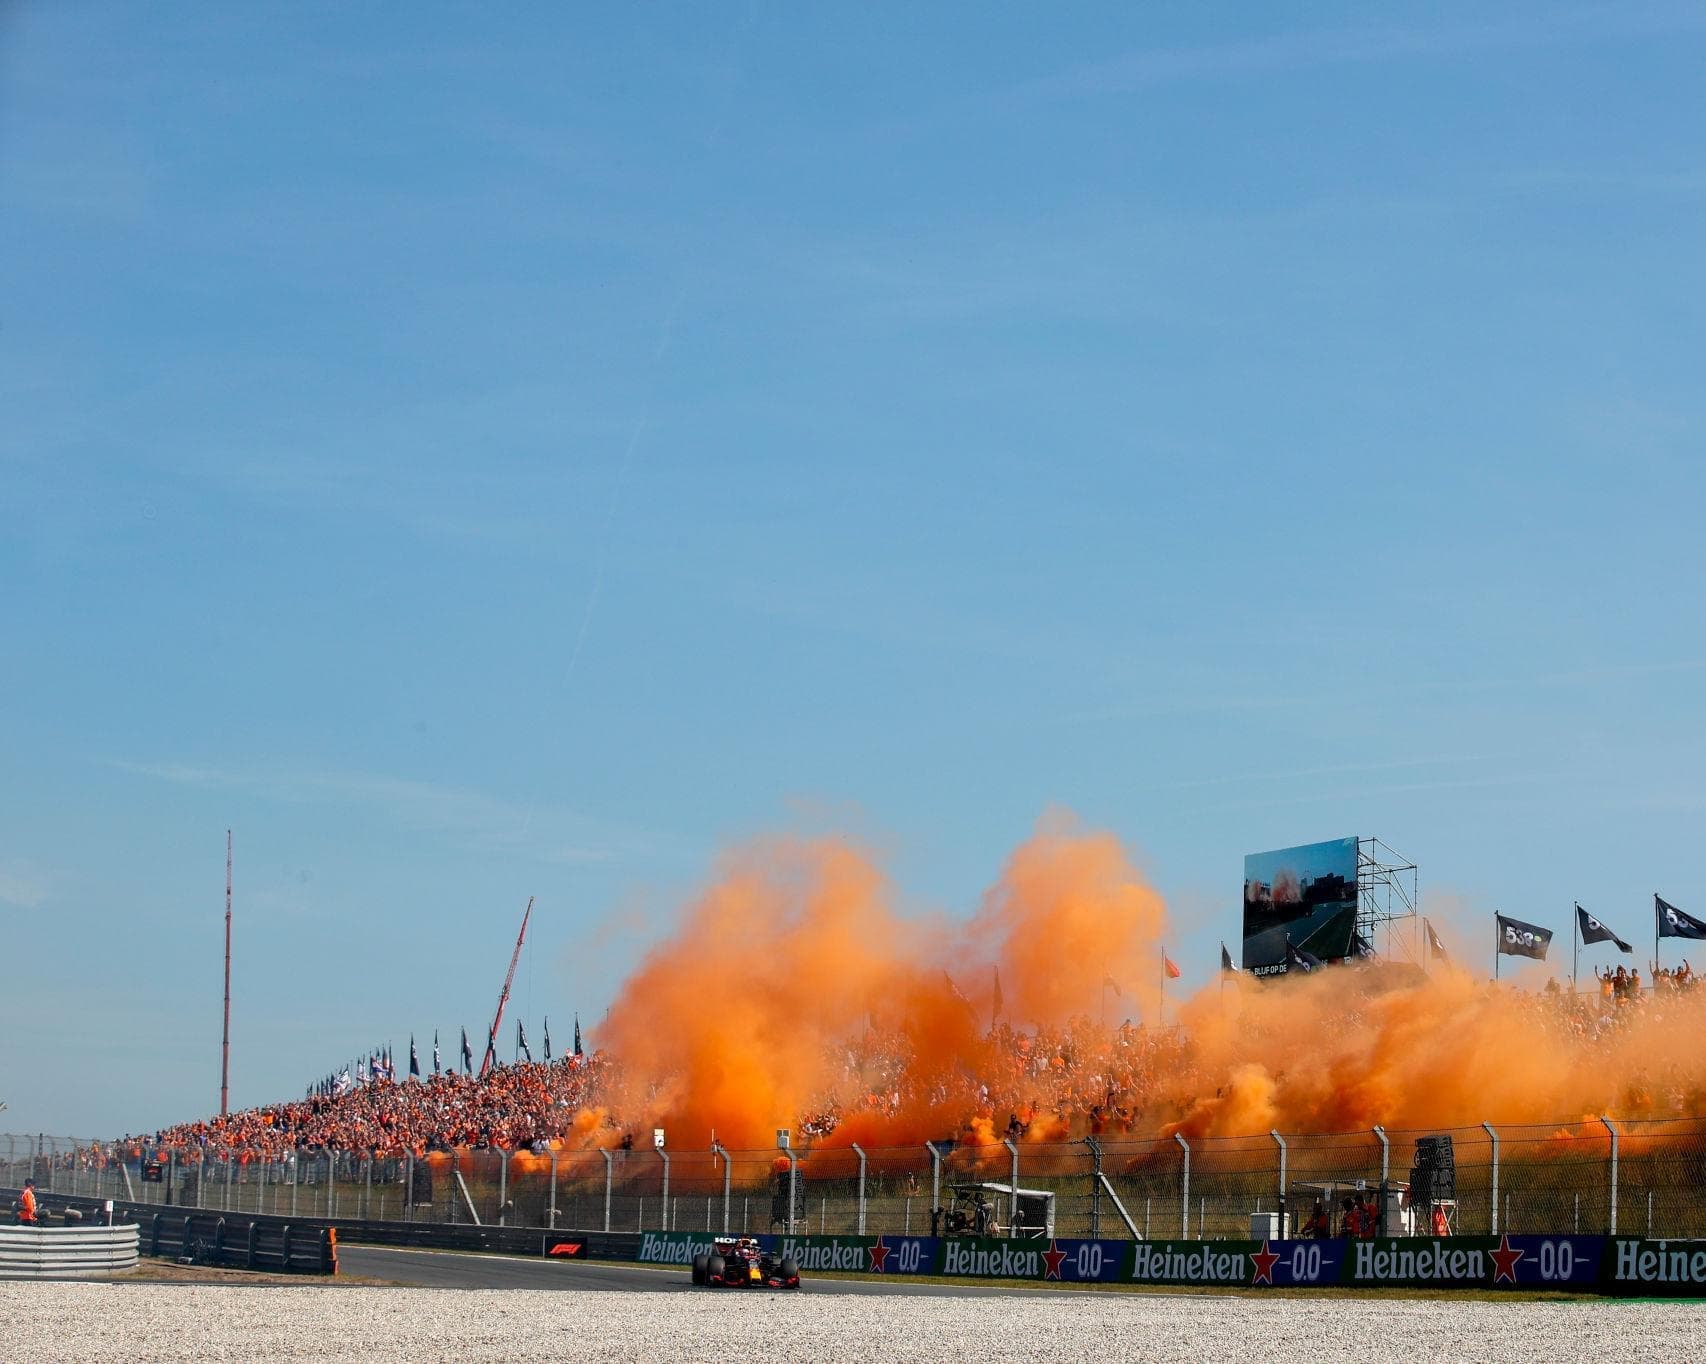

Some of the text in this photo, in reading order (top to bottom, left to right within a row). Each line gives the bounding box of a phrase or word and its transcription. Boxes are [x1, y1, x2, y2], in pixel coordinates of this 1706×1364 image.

[714, 1237, 758, 1245] HONA
[783, 1238, 864, 1270] Heineken
[944, 1242, 1038, 1276] Heineken
[1132, 1244, 1246, 1280] Heineken
[1355, 1242, 1486, 1279] Heineken
